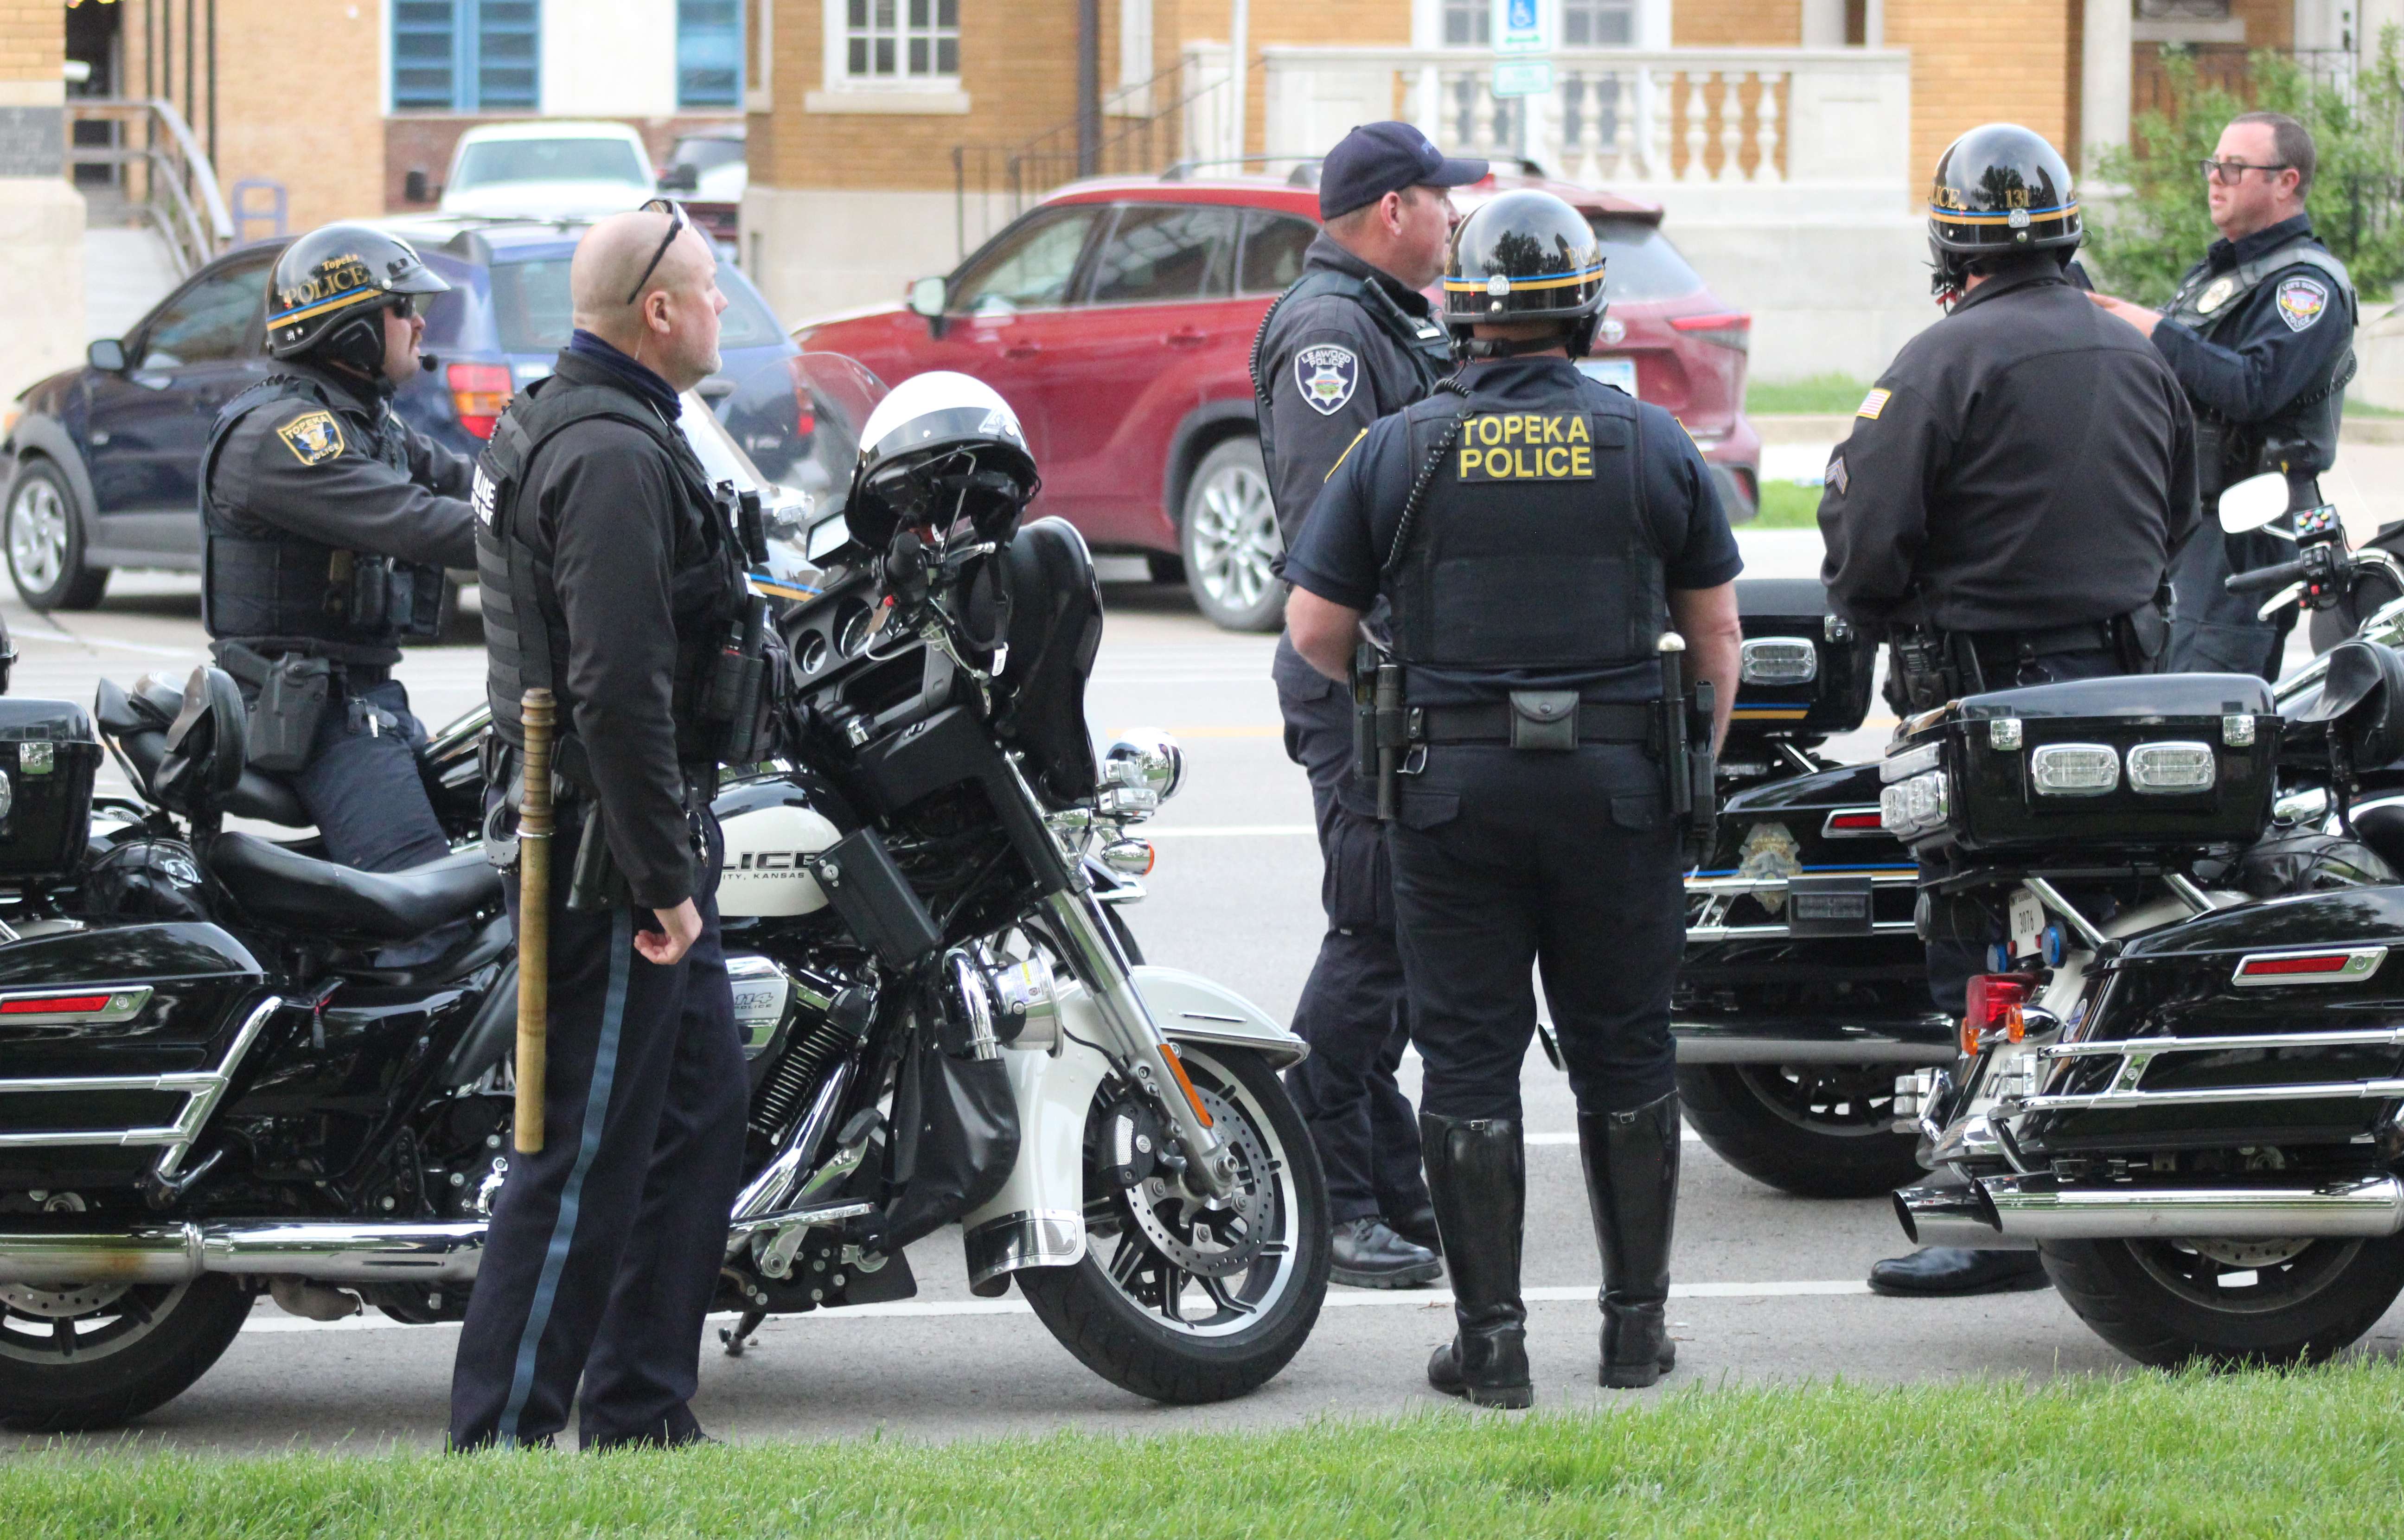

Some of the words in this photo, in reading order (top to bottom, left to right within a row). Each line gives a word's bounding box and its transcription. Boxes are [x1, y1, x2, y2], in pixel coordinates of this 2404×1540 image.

[2005, 188, 2031, 208] 131
[322, 254, 358, 271] Topeka
[283, 265, 368, 308] POLICE
[1489, 282, 1509, 292] DOT
[2287, 311, 2310, 327] POLICE
[1301, 351, 1351, 364] LEAWOOD
[1310, 358, 1345, 369] POLICE
[286, 416, 330, 440] TOPEKA
[1464, 415, 1590, 446] TOPEKA
[308, 443, 340, 463] POLICE
[1460, 446, 1592, 478] POLICE
[2019, 910, 2034, 934] 3076
[735, 992, 774, 1005] 114
